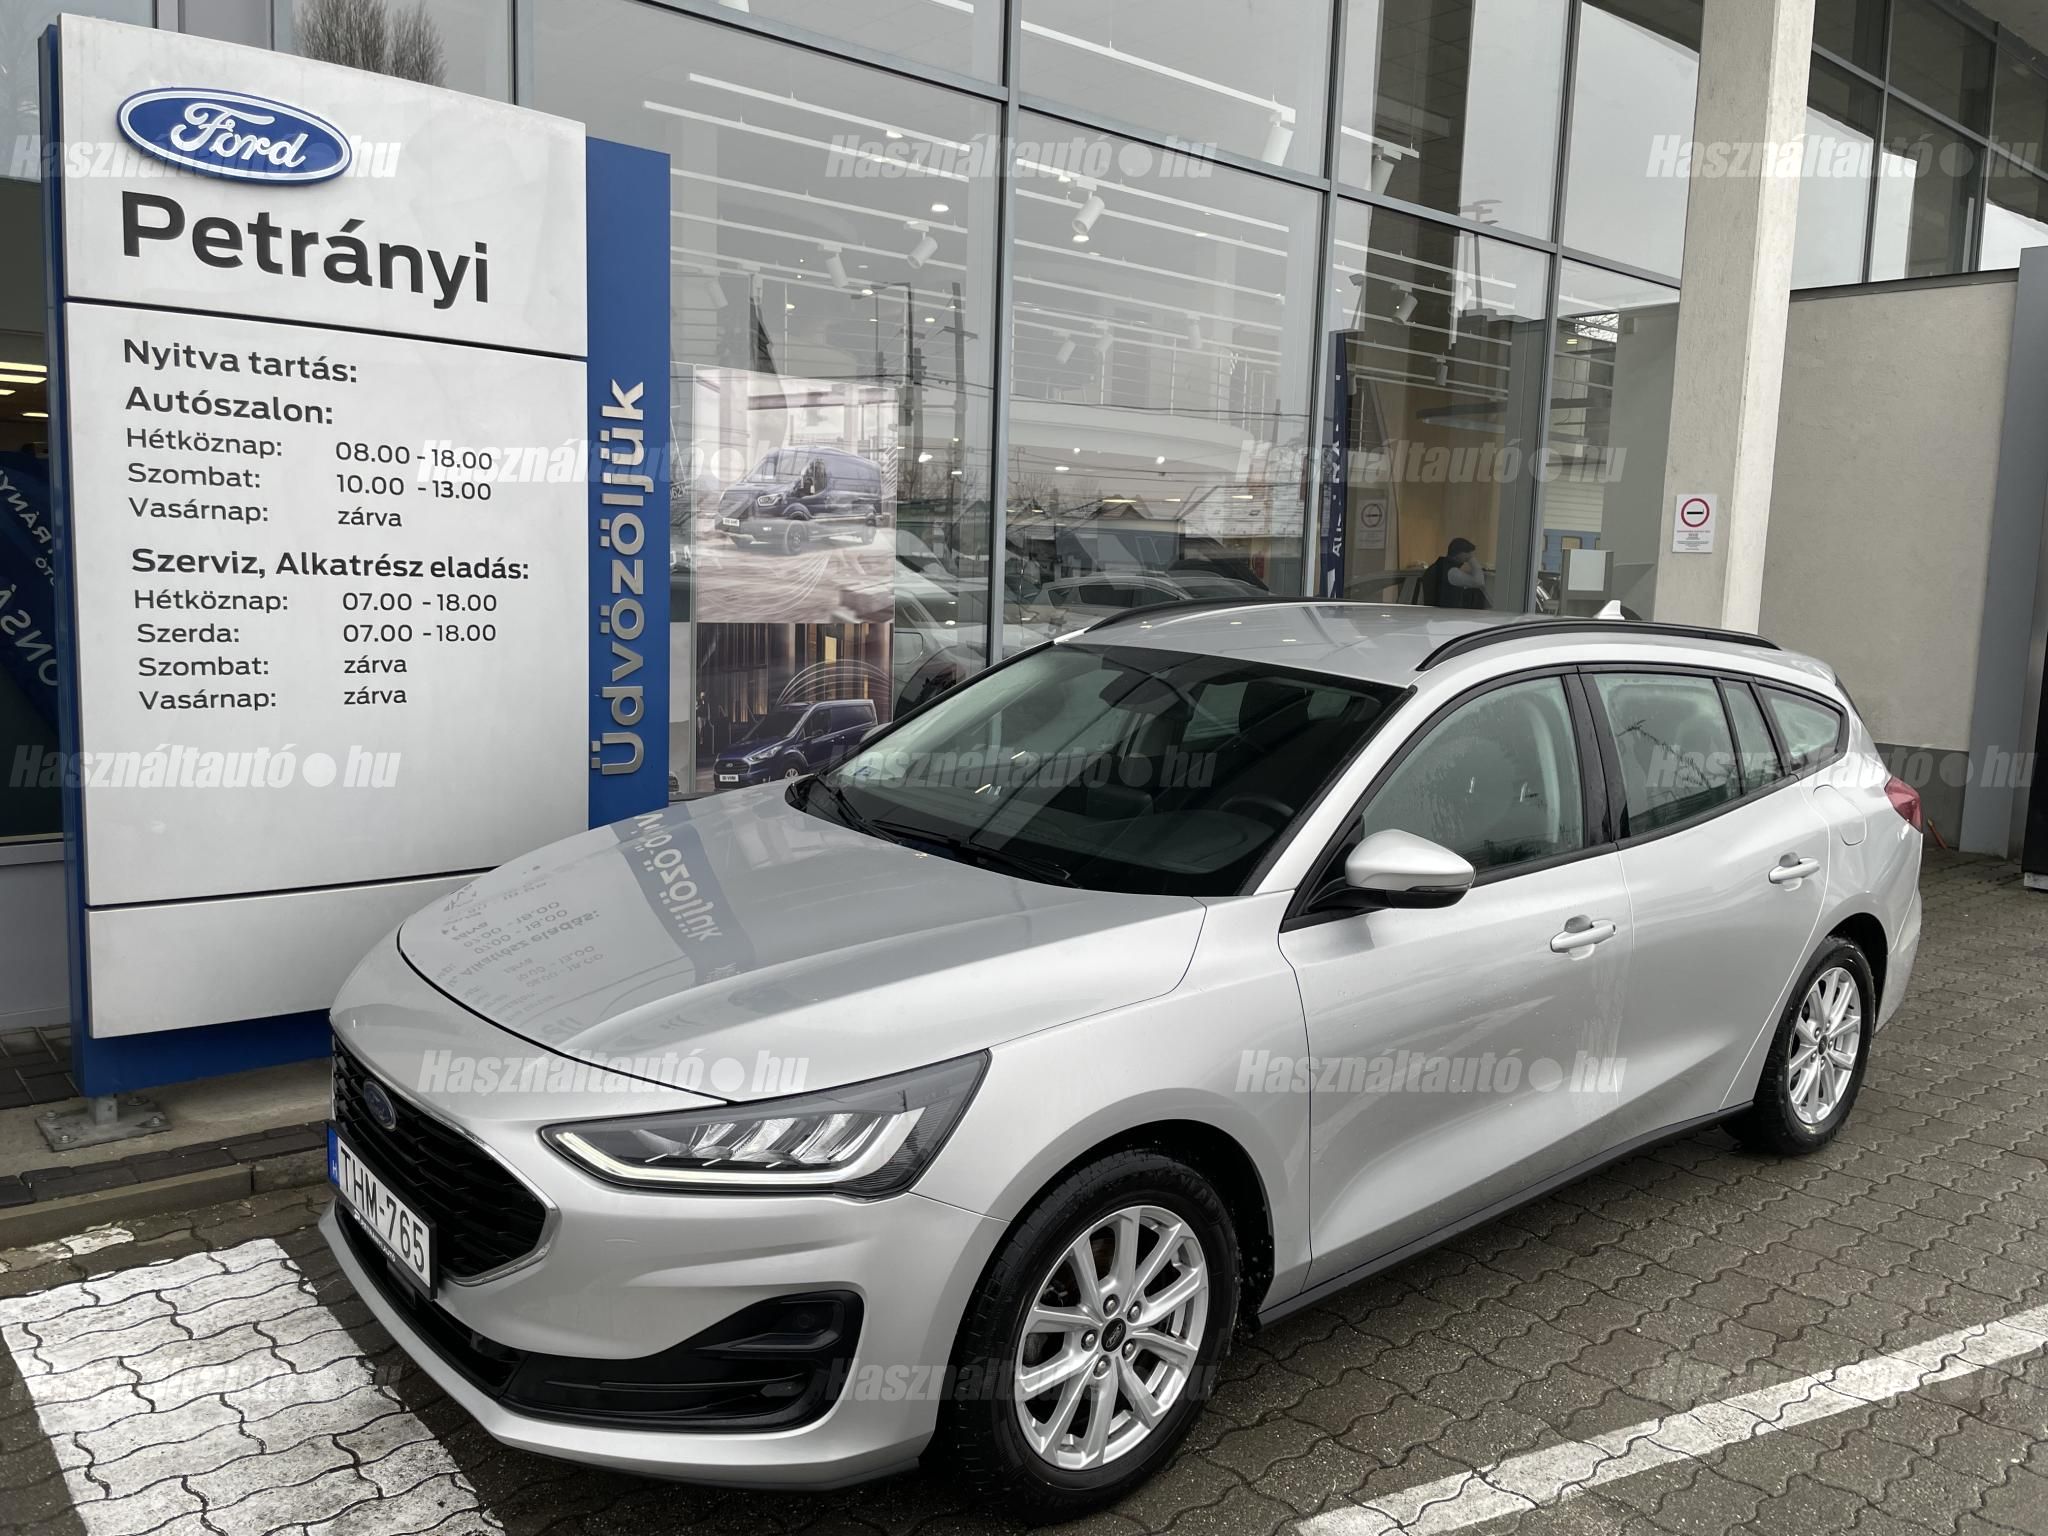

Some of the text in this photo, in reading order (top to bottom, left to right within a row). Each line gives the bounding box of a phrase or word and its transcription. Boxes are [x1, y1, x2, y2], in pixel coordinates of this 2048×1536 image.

[171, 102, 306, 168] Ford
[122, 190, 488, 310] Petrányi
[123, 338, 357, 383] Nyitva tartás:
[125, 386, 333, 425] Autószalon:
[127, 427, 282, 459] Hétköznap:
[335, 441, 410, 465] 08.00
[128, 462, 260, 488] Szombat:
[336, 474, 404, 496] 10.00
[128, 497, 402, 527] Vasárnap: zárva
[131, 548, 529, 580] Szerviz, Alkatrész eladás:
[591, 379, 654, 776] Üdvözöljük
[134, 589, 288, 614] Hétköznap:
[342, 592, 412, 611] 07.00
[137, 623, 239, 643] Szerda:
[343, 624, 413, 643] 07.00
[138, 654, 408, 677] Szombat: zárva
[138, 685, 407, 711] Vasárnap: zárva
[340, 1146, 425, 1273] THM-765
